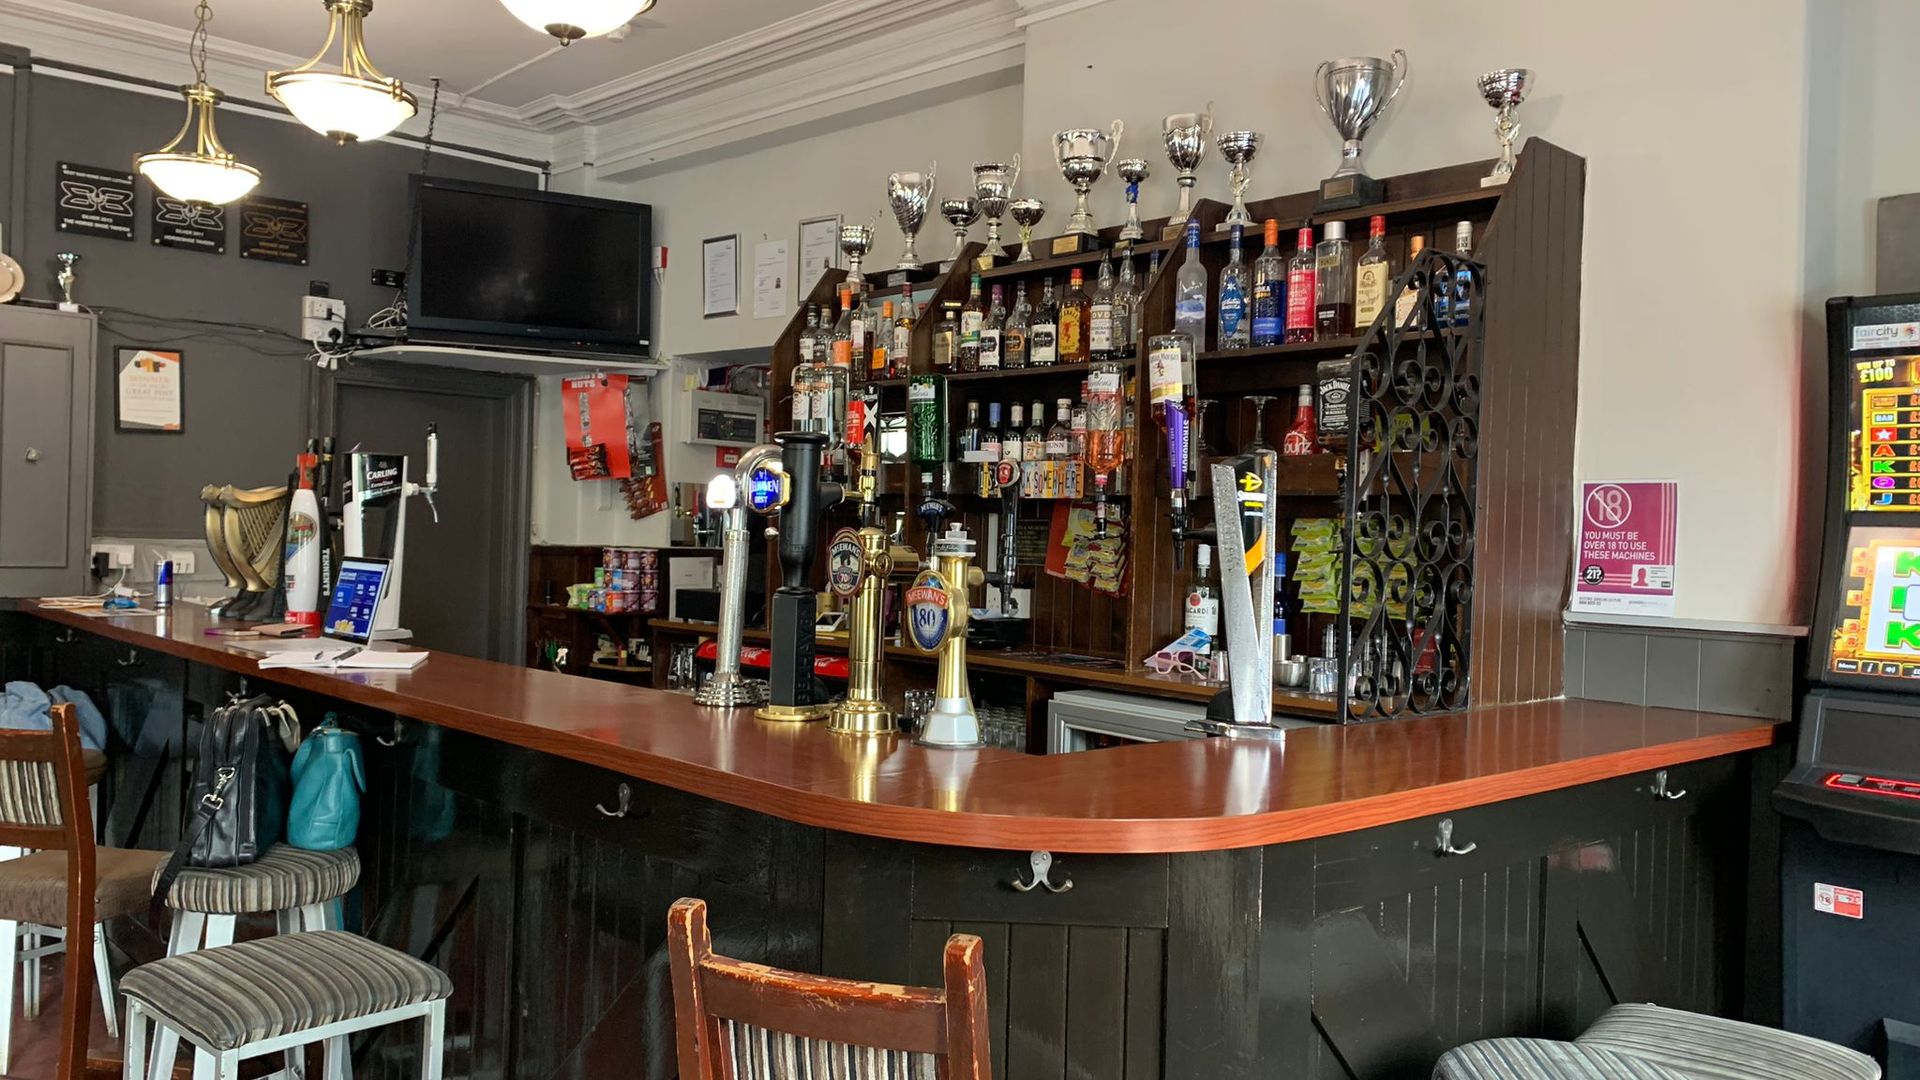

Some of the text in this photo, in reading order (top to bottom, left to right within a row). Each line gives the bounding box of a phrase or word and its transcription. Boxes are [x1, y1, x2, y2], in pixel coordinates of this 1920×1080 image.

[1872, 360, 1884, 369] UP
[1884, 358, 1896, 368] TO
[1860, 366, 1894, 384] £100
[1320, 382, 1333, 396] JACK
[1872, 460, 1896, 473] K
[366, 467, 398, 480] CARLING
[754, 496, 768, 504] BEST
[1874, 492, 1892, 505] J
[1584, 531, 1639, 541] YOU MUST BE
[1584, 541, 1648, 551] OVER 18 TO USE
[1583, 550, 1656, 561] THESE MACHINES
[1586, 569, 1602, 580] 21?
